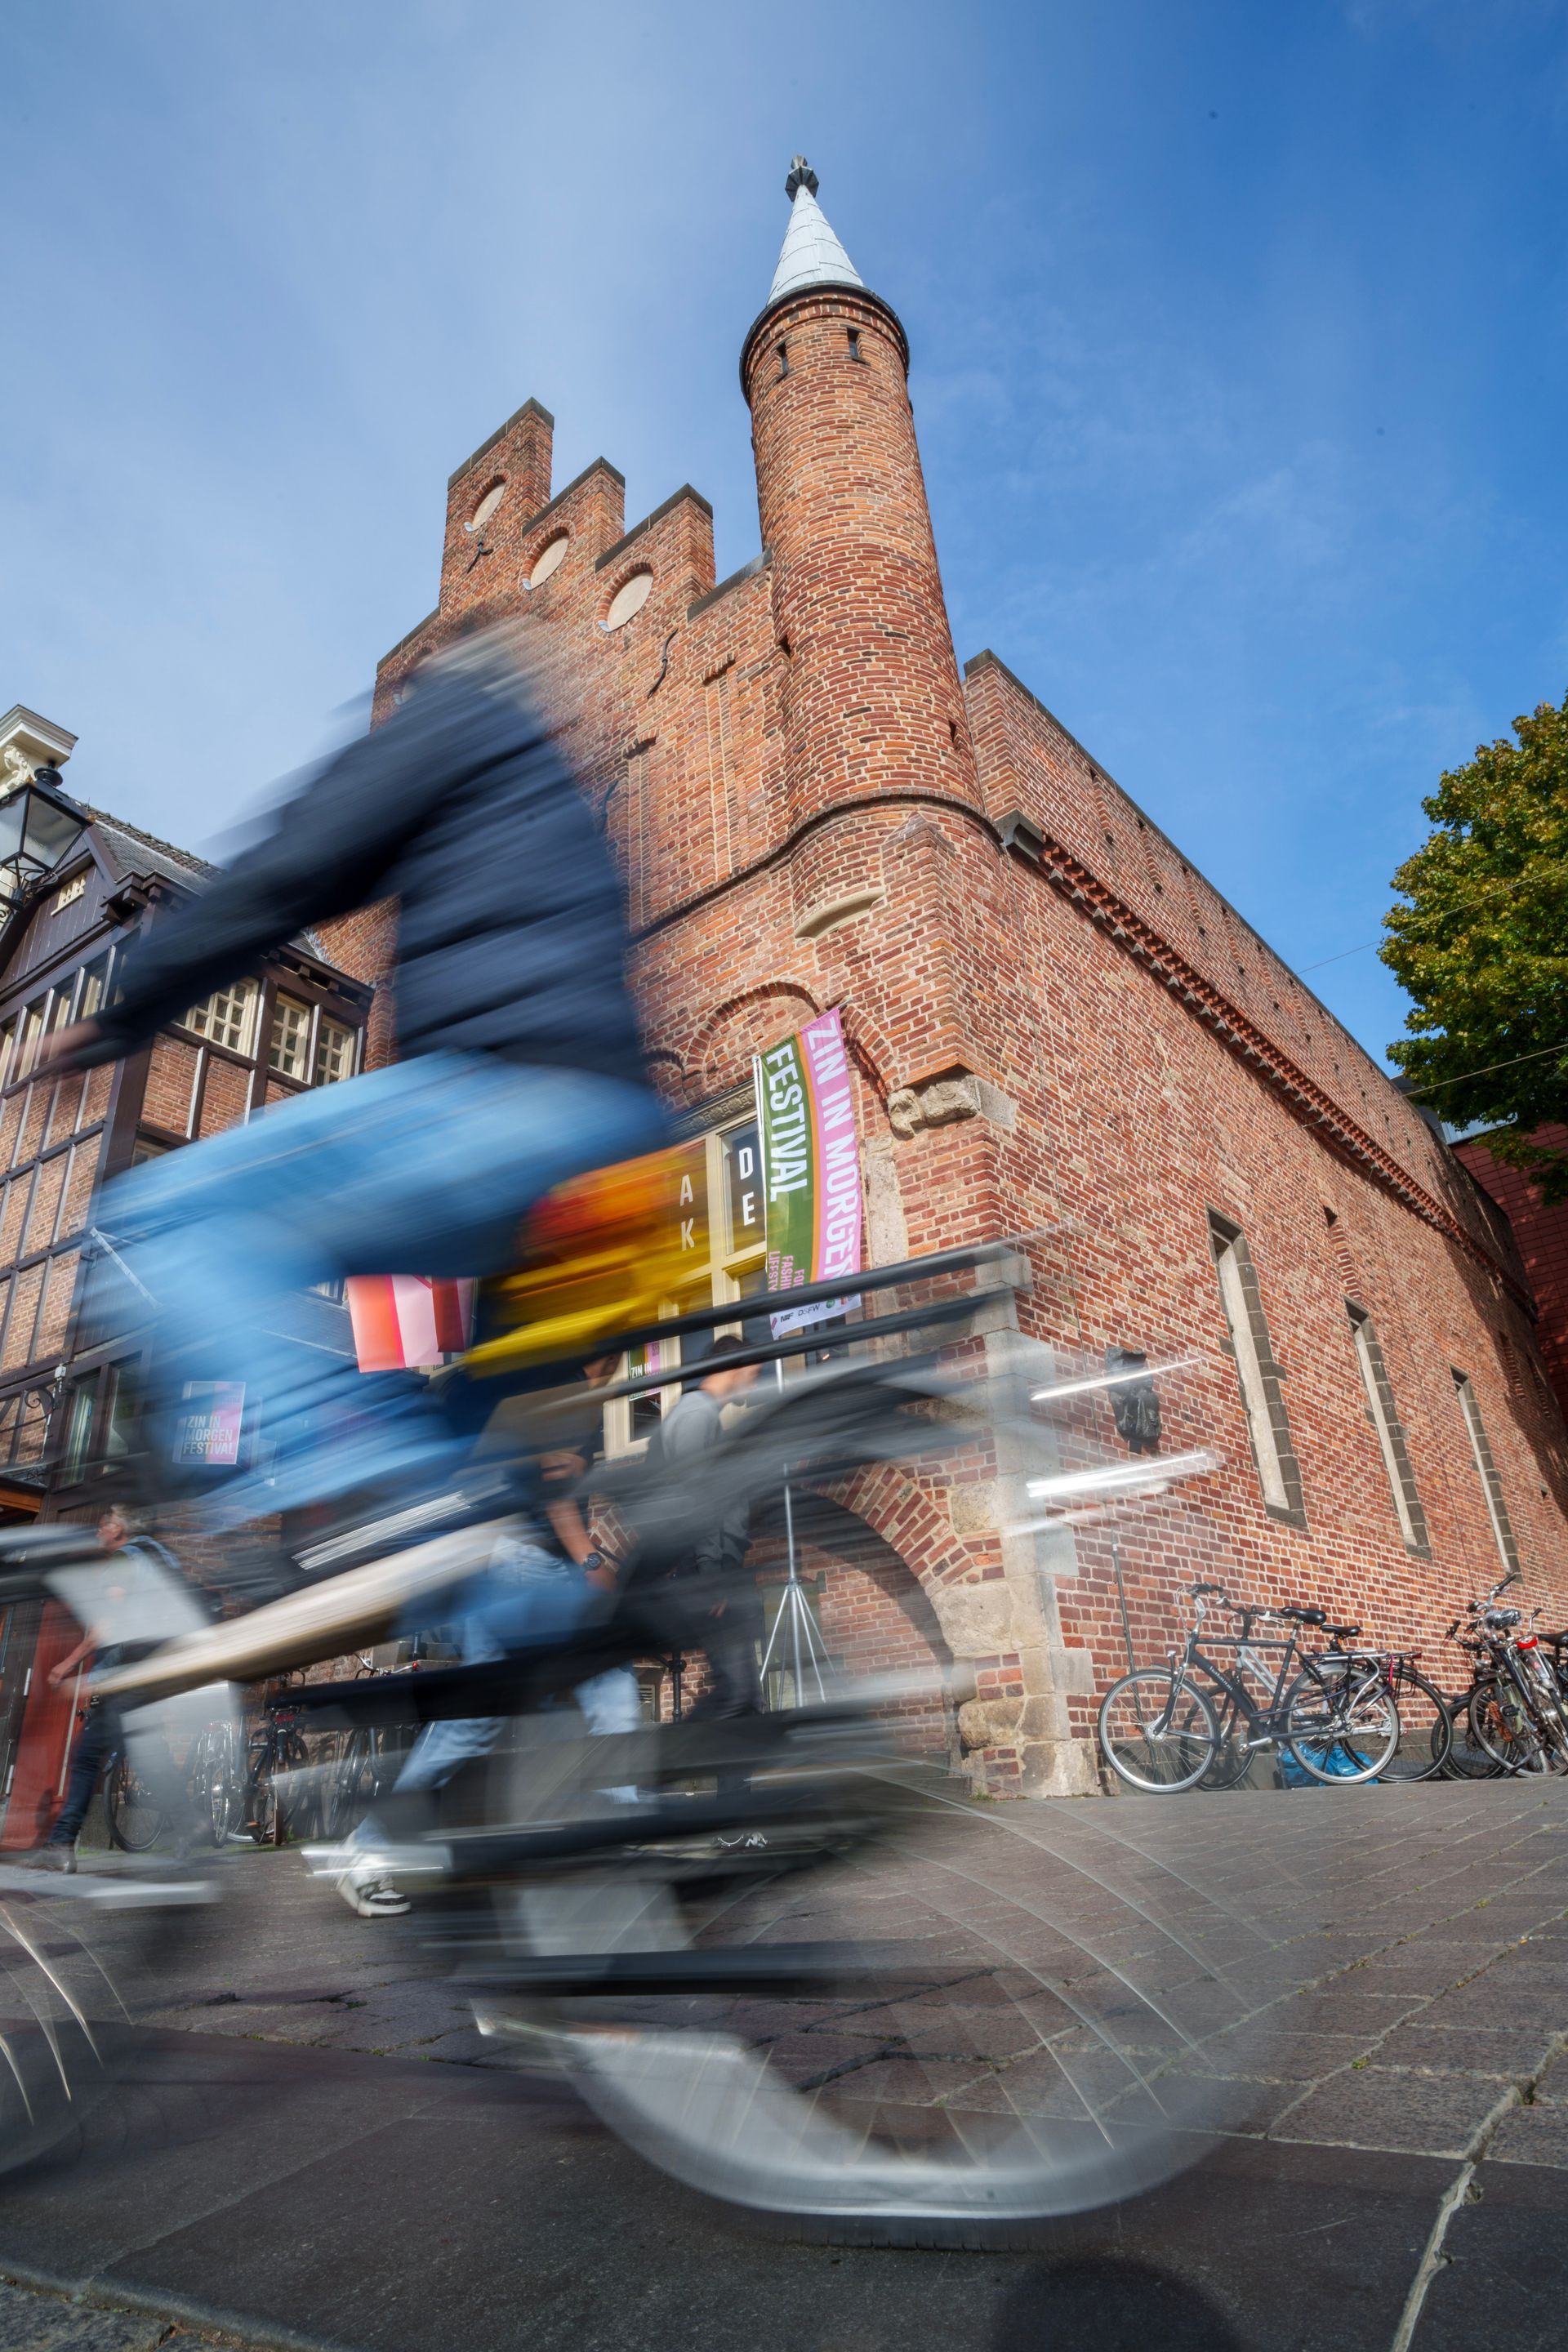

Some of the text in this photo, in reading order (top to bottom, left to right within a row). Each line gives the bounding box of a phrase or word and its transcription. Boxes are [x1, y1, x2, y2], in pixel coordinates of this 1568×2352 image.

[808, 1017, 846, 1085] ZIN
[821, 1085, 853, 1131] IN
[766, 1044, 808, 1202] FESTIVAL
[630, 1361, 652, 1379] ZIN IN
[188, 1415, 220, 1428] ZIN IN
[185, 1429, 232, 1441] MORGEN
[183, 1442, 234, 1454] FESTIVAL
